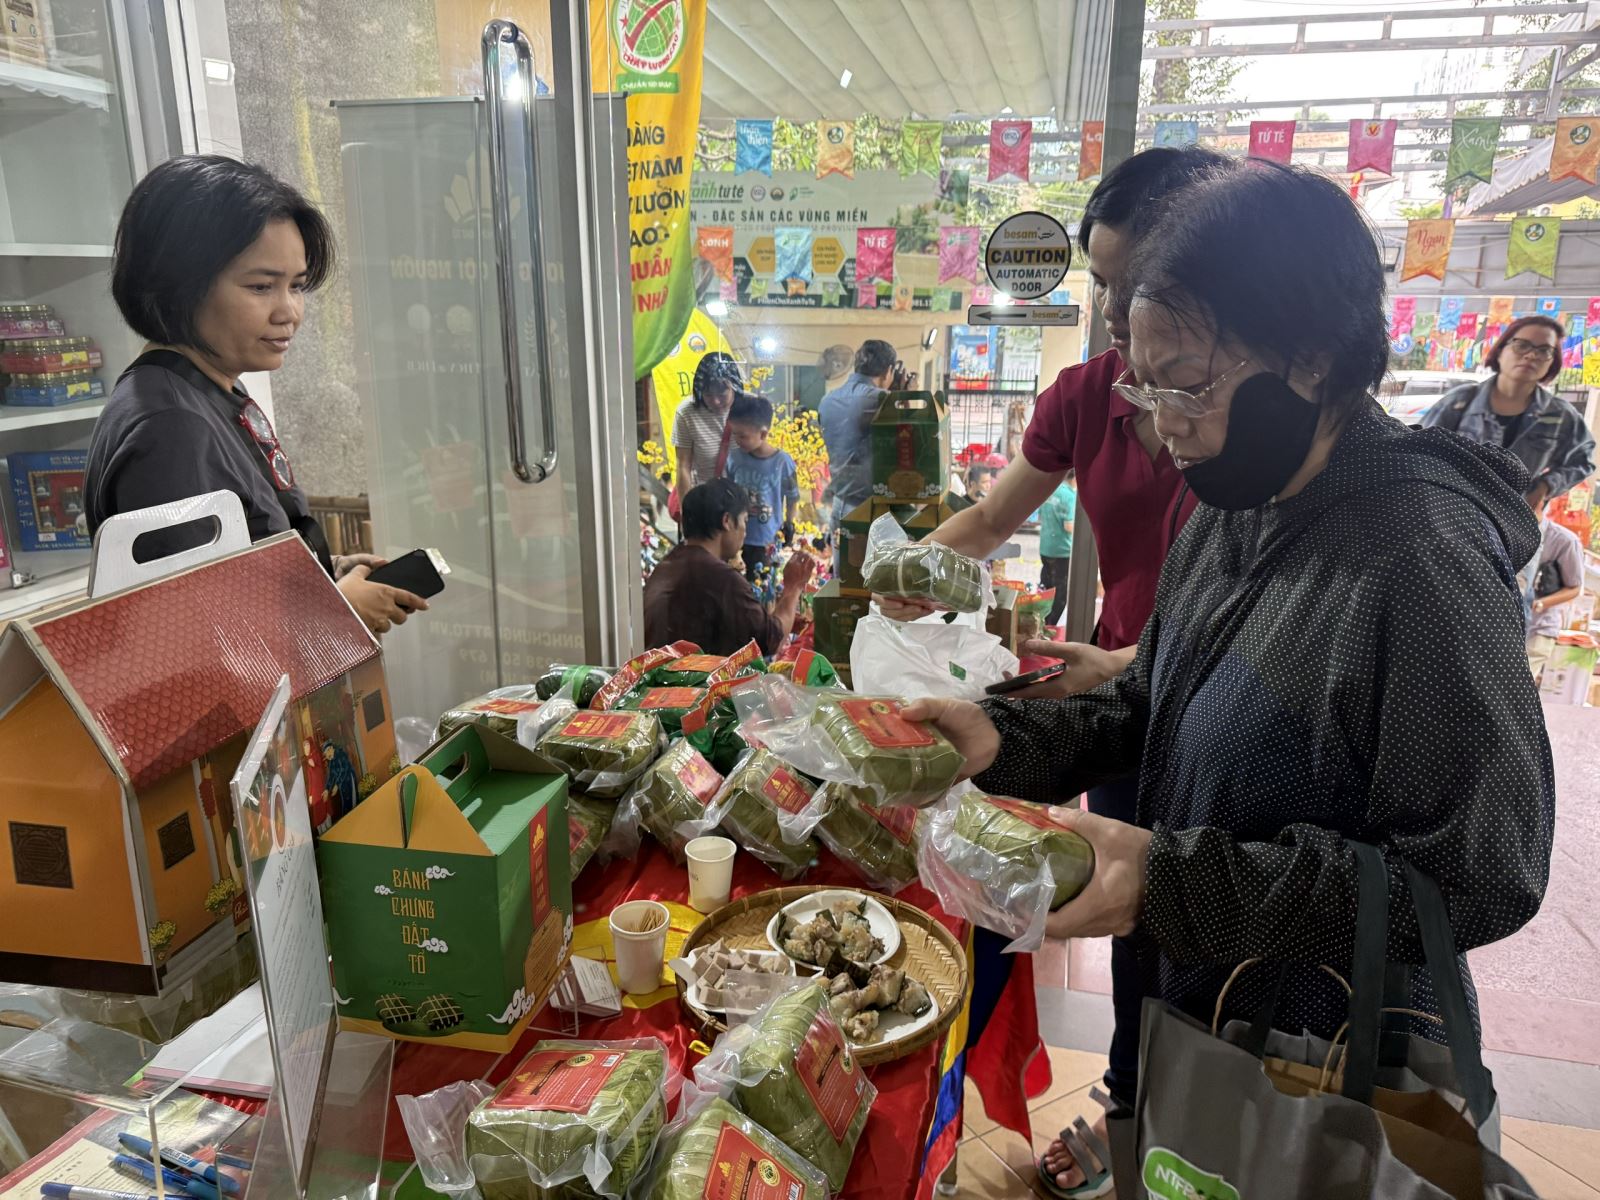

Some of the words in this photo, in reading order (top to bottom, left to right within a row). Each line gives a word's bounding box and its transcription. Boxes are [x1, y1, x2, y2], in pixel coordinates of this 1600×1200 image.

[712, 210, 735, 225] ĐẶC
[770, 207, 793, 222] CÁC
[799, 207, 831, 222] VÙNG
[1004, 229, 1038, 239] besam
[991, 250, 1066, 264] CAUTION
[996, 269, 1060, 279] AUTOMATIC
[1011, 282, 1042, 292] DOOR
[1031, 310, 1059, 319] besam
[392, 867, 430, 890] BÁNH
[408, 949, 426, 974] TỔ
